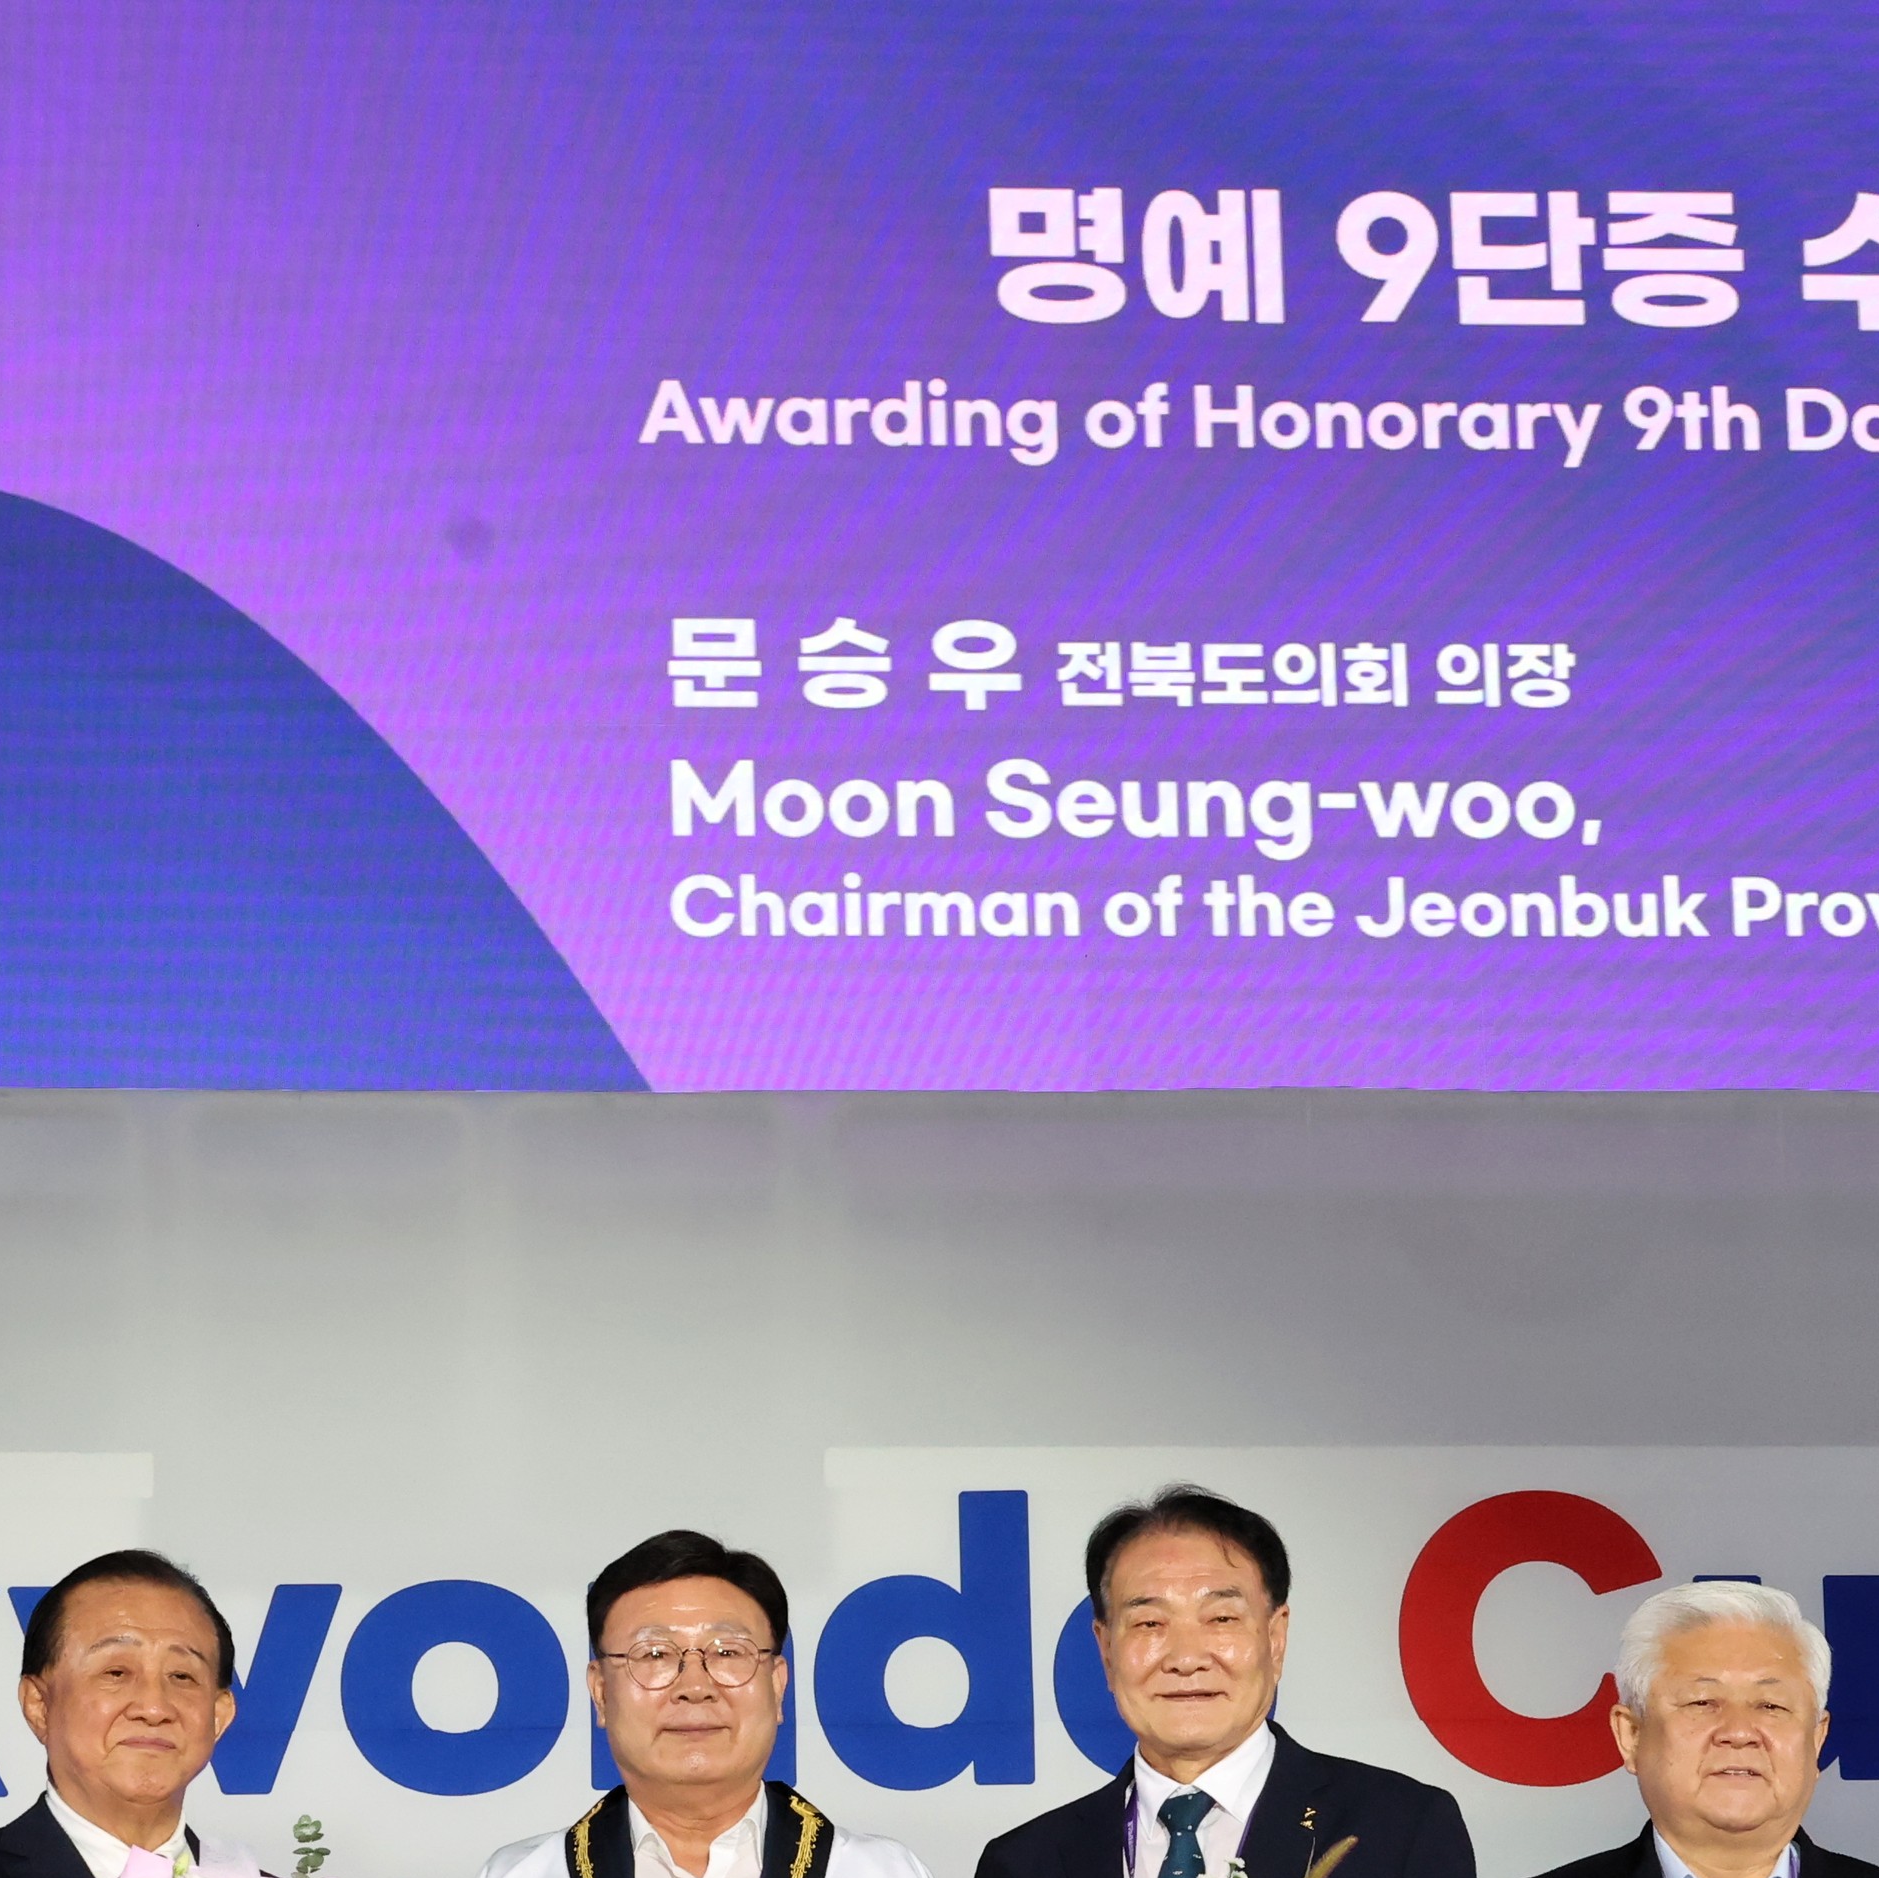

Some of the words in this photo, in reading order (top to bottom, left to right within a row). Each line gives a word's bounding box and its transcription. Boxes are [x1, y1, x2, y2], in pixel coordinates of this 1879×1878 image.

[988, 186, 1286, 324] 명예
[1335, 190, 1745, 328] 9단증
[639, 379, 1059, 467] Awarding
[1084, 382, 1170, 450] of
[1194, 384, 1602, 469] Honorary
[1623, 385, 1760, 452] 9th
[1056, 641, 1407, 708] 전북도의회
[1435, 641, 1576, 708] 의장
[669, 759, 955, 839] Moon
[985, 758, 1602, 861] Seung-woo,
[669, 873, 1080, 939] Chairman
[1104, 873, 1184, 938] of
[1204, 873, 1335, 938] the
[1356, 874, 1709, 939] Jeonbuk
